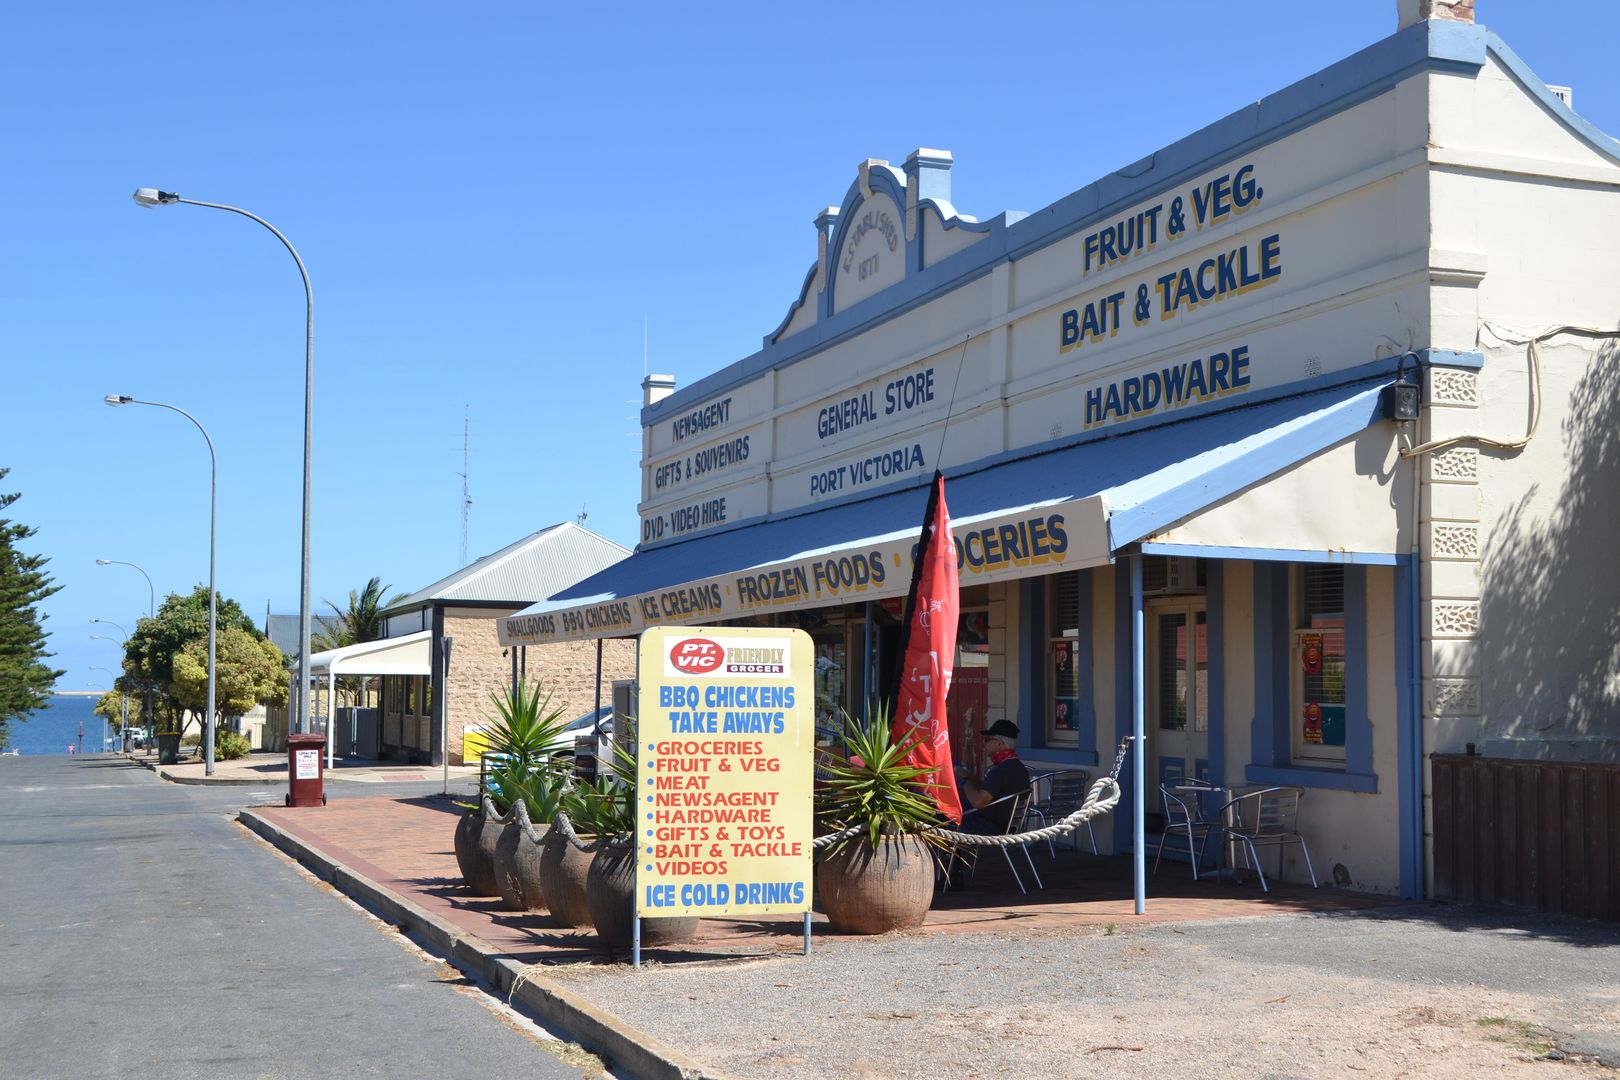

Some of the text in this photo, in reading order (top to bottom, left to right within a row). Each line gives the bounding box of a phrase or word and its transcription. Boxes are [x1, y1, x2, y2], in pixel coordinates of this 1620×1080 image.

[1083, 164, 1264, 274] FRUIT & VEG.
[1060, 233, 1282, 350] BAIT & TACKLE
[1084, 345, 1251, 427] HARDWARE
[817, 368, 934, 439] GENERAL STORE
[671, 397, 732, 442] NEWSAGENT
[655, 435, 750, 489] GIFTS & SOUVENIRS
[810, 444, 925, 497] PORT VICTORIA
[644, 517, 664, 541] DVD
[671, 503, 700, 533] VIDEO
[702, 497, 726, 524] HIRE
[506, 614, 555, 638] SMALLGOODS
[586, 601, 632, 629] CHICKENS
[639, 595, 660, 621] ICE
[661, 583, 722, 617] CREAMS
[736, 565, 809, 604] FROZEN
[812, 551, 886, 592] FOODS
[911, 514, 1068, 571] CERIES
[681, 643, 717, 655] PT.
[726, 647, 785, 664] FRIENDLY
[677, 656, 716, 667] VIC
[730, 665, 780, 673] GROCER
[659, 685, 795, 710] BBQ CHICKENS
[669, 711, 785, 735] TAKE AWAYS
[656, 741, 763, 756] GROCERIES
[656, 757, 780, 773] FRUIT & VEG
[656, 775, 710, 790] MEAT
[656, 791, 779, 807] NEWSAGENT
[656, 808, 771, 824] HARDWARE
[656, 826, 785, 841] GIFTS & TOYS
[655, 842, 802, 858] BAIT & TACKLE
[656, 861, 728, 875] VIDEOS
[645, 882, 805, 908] ICE COLD DRINKS
